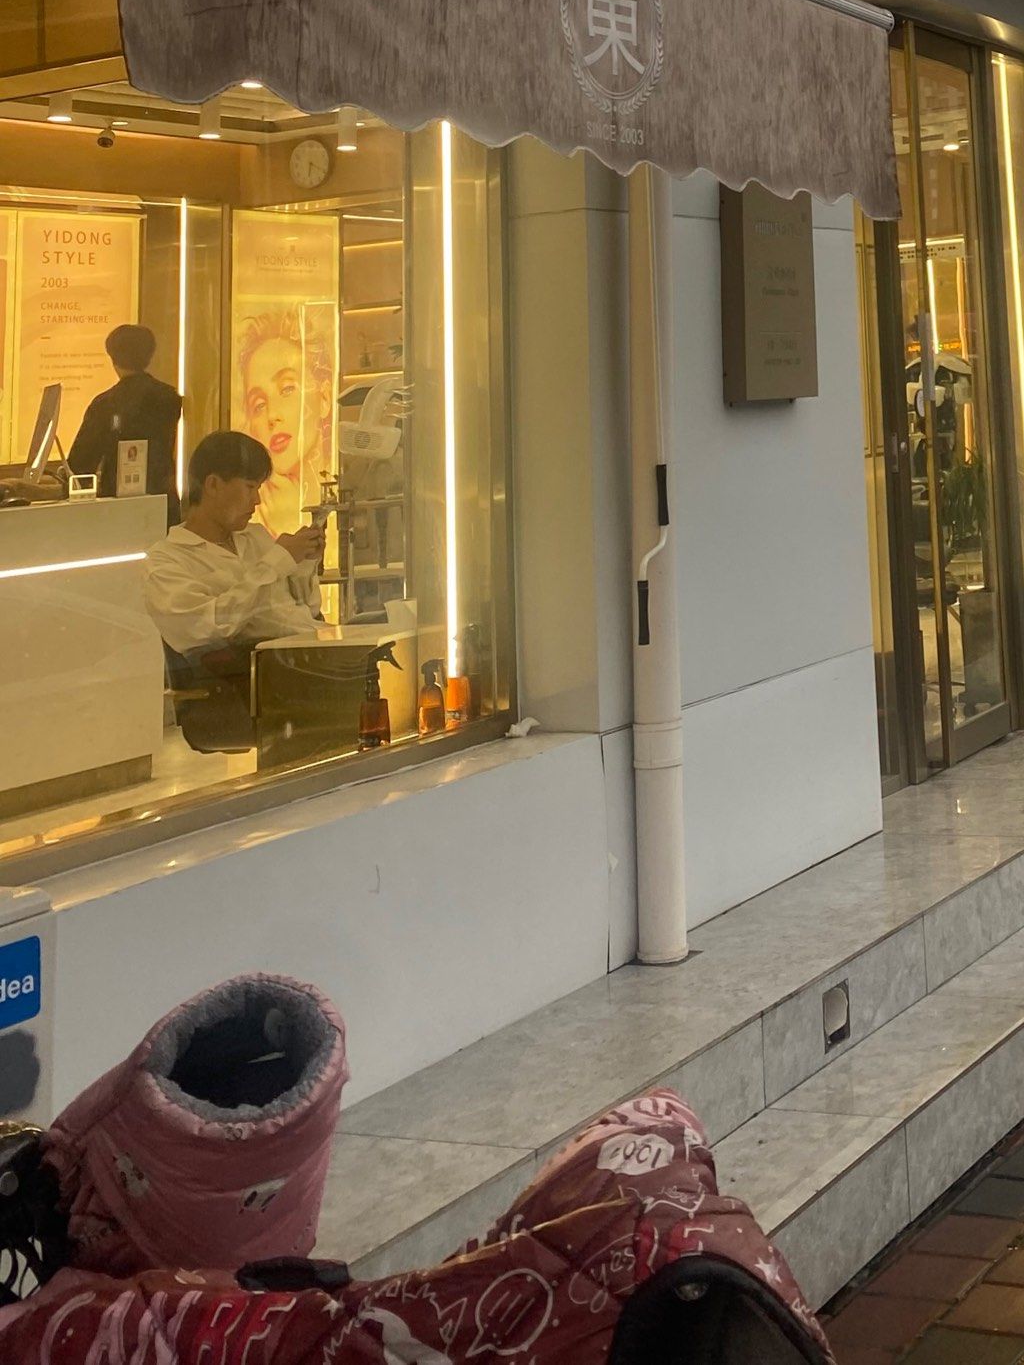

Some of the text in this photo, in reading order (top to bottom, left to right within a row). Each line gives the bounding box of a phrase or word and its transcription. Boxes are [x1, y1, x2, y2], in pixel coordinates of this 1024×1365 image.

[620, 124, 644, 145] 2003
[43, 230, 112, 245] YIDONG
[42, 251, 96, 265] STYLE
[41, 277, 69, 288] 2003
[41, 316, 85, 324] STARTING
